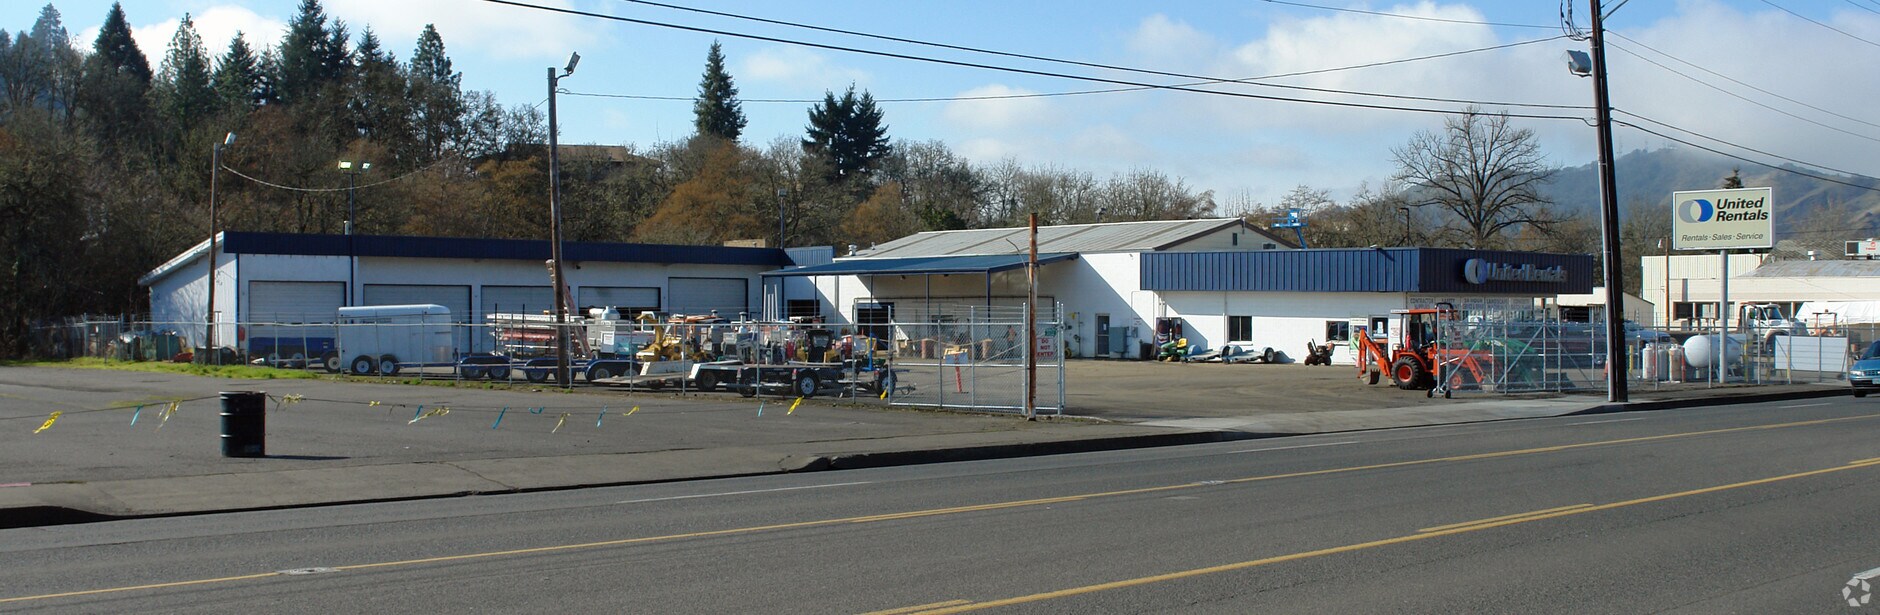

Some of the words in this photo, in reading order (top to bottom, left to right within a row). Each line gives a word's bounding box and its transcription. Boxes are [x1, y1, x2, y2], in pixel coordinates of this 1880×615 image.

[1716, 197, 1764, 209] United
[1716, 209, 1768, 222] Rentals
[1681, 234, 1708, 242] Rentals
[1711, 233, 1732, 241] Sales
[1736, 232, 1763, 240] Service
[1486, 262, 1525, 281] United
[1525, 264, 1567, 282] Rentals
